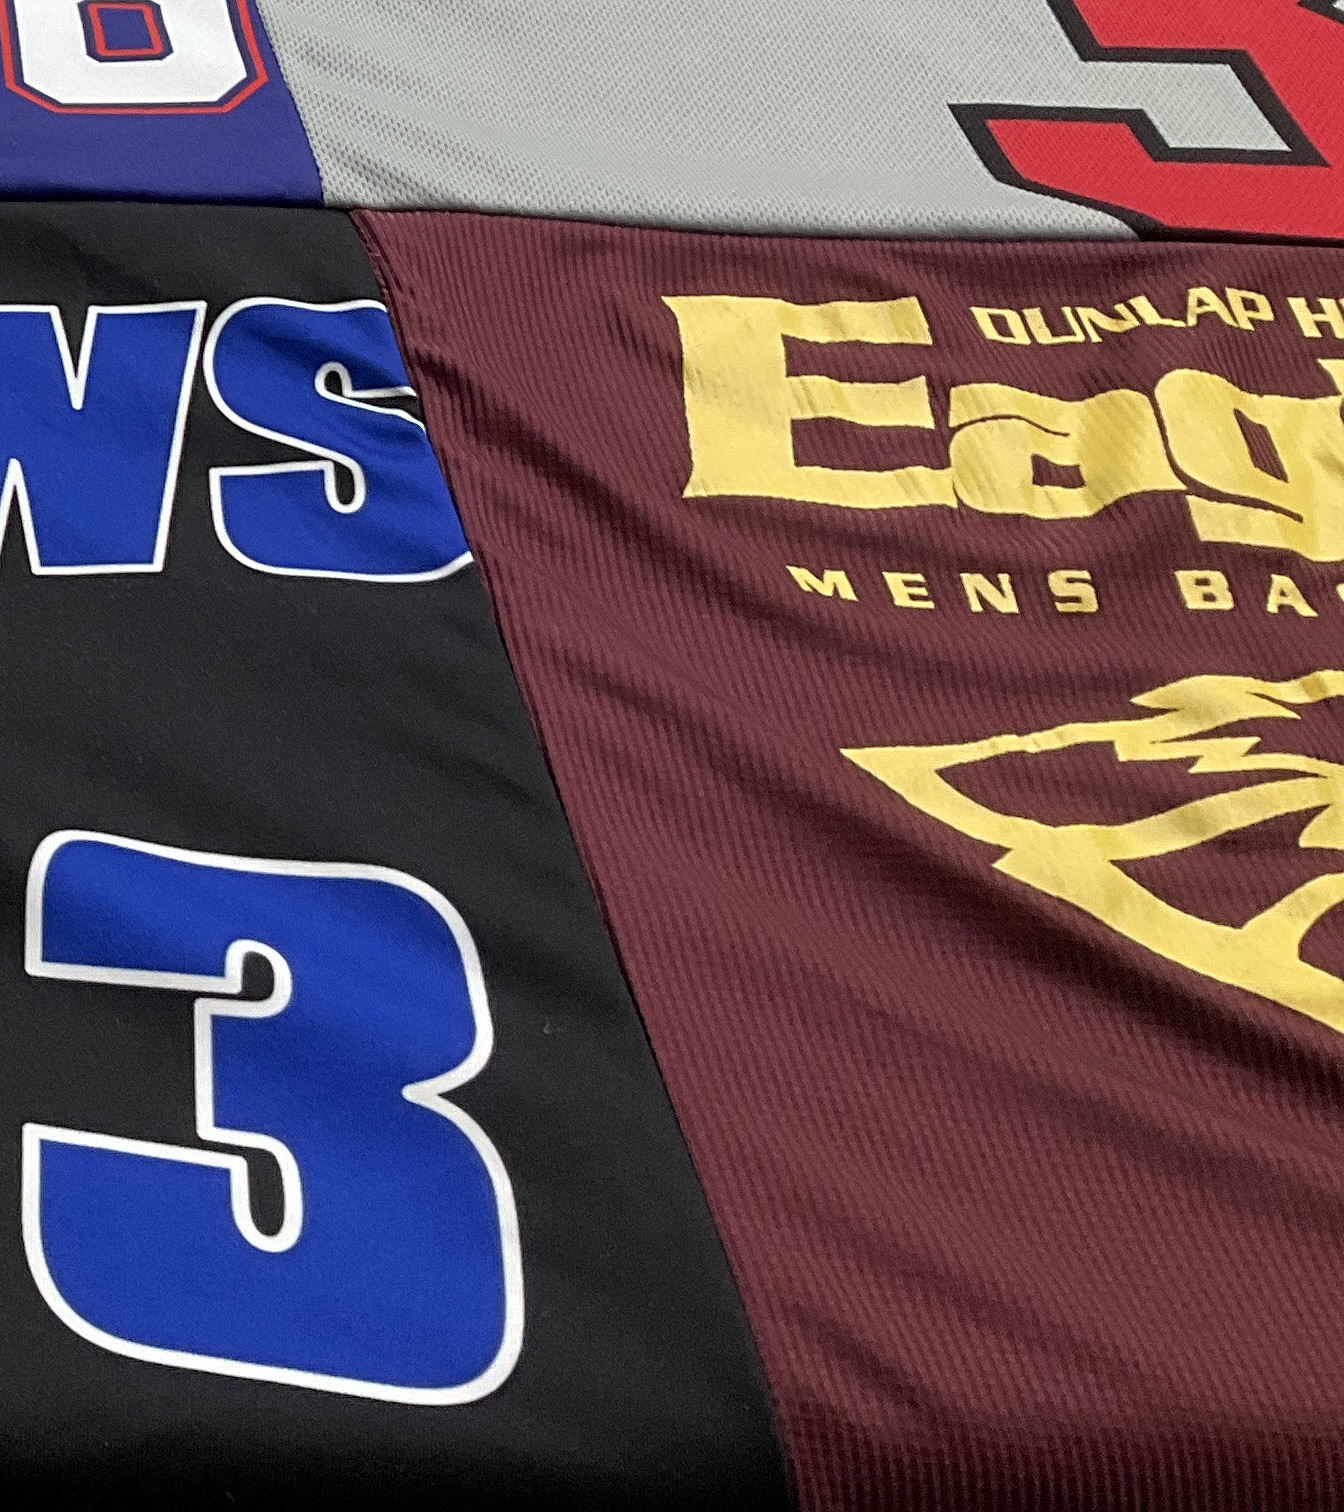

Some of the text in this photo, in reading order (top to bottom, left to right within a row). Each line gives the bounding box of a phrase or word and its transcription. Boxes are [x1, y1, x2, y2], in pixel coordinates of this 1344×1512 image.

[969, 286, 1275, 346] DUNLAP
[661, 295, 1344, 563] Eag
[785, 565, 1344, 618] MENS BA
[21, 828, 526, 1406] 3
